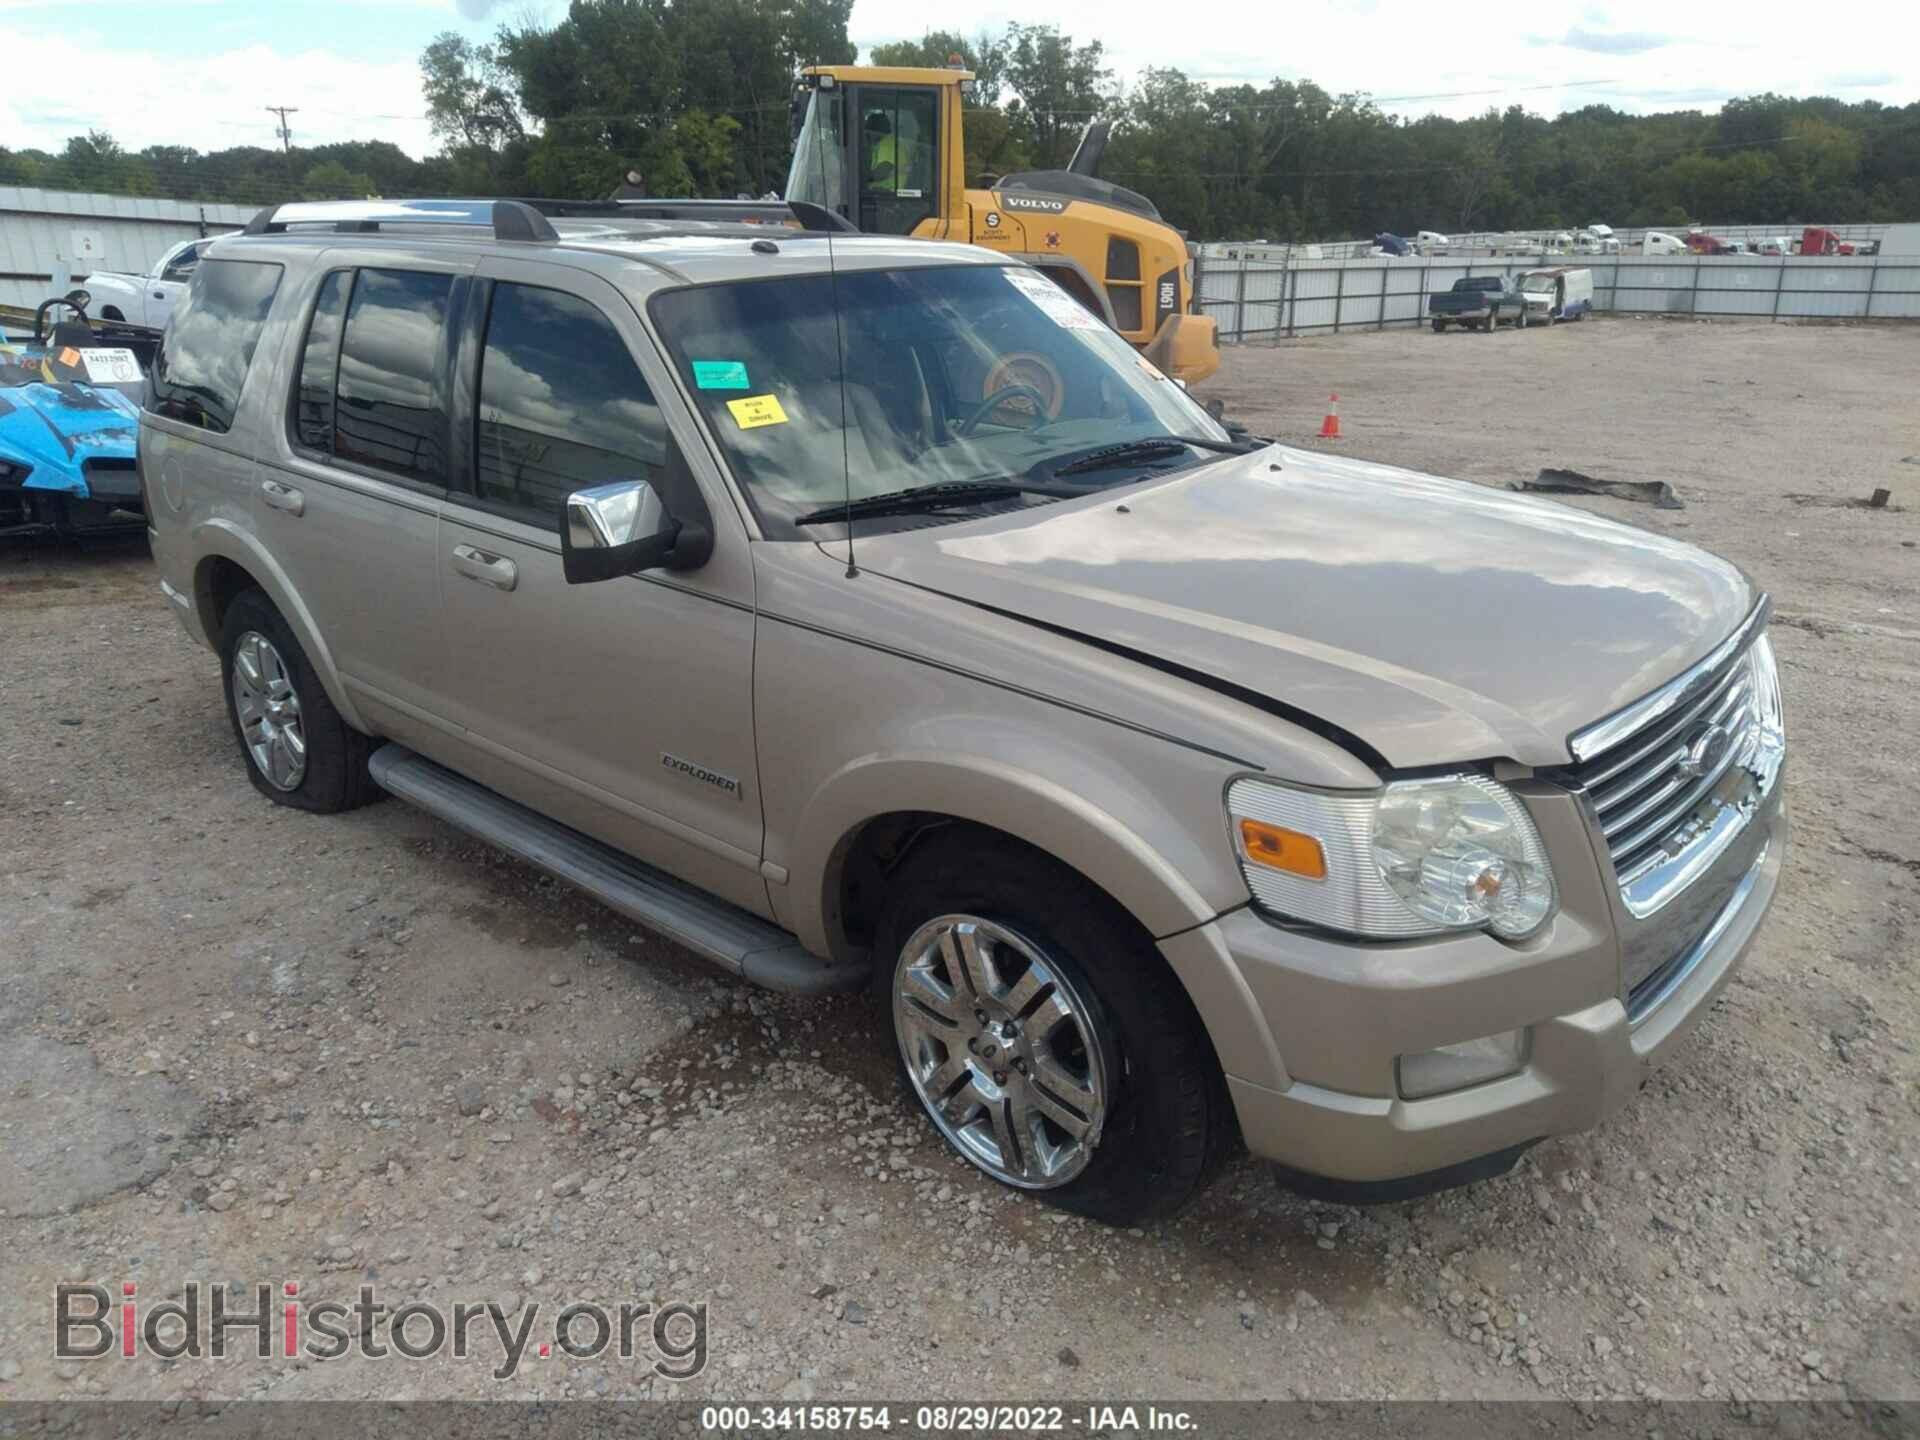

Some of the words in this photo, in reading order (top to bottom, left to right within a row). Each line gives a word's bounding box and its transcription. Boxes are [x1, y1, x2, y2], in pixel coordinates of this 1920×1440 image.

[1008, 198, 1062, 210] VOLVO
[1161, 283, 1174, 308] L90H
[663, 755, 736, 792] EXPLORER
